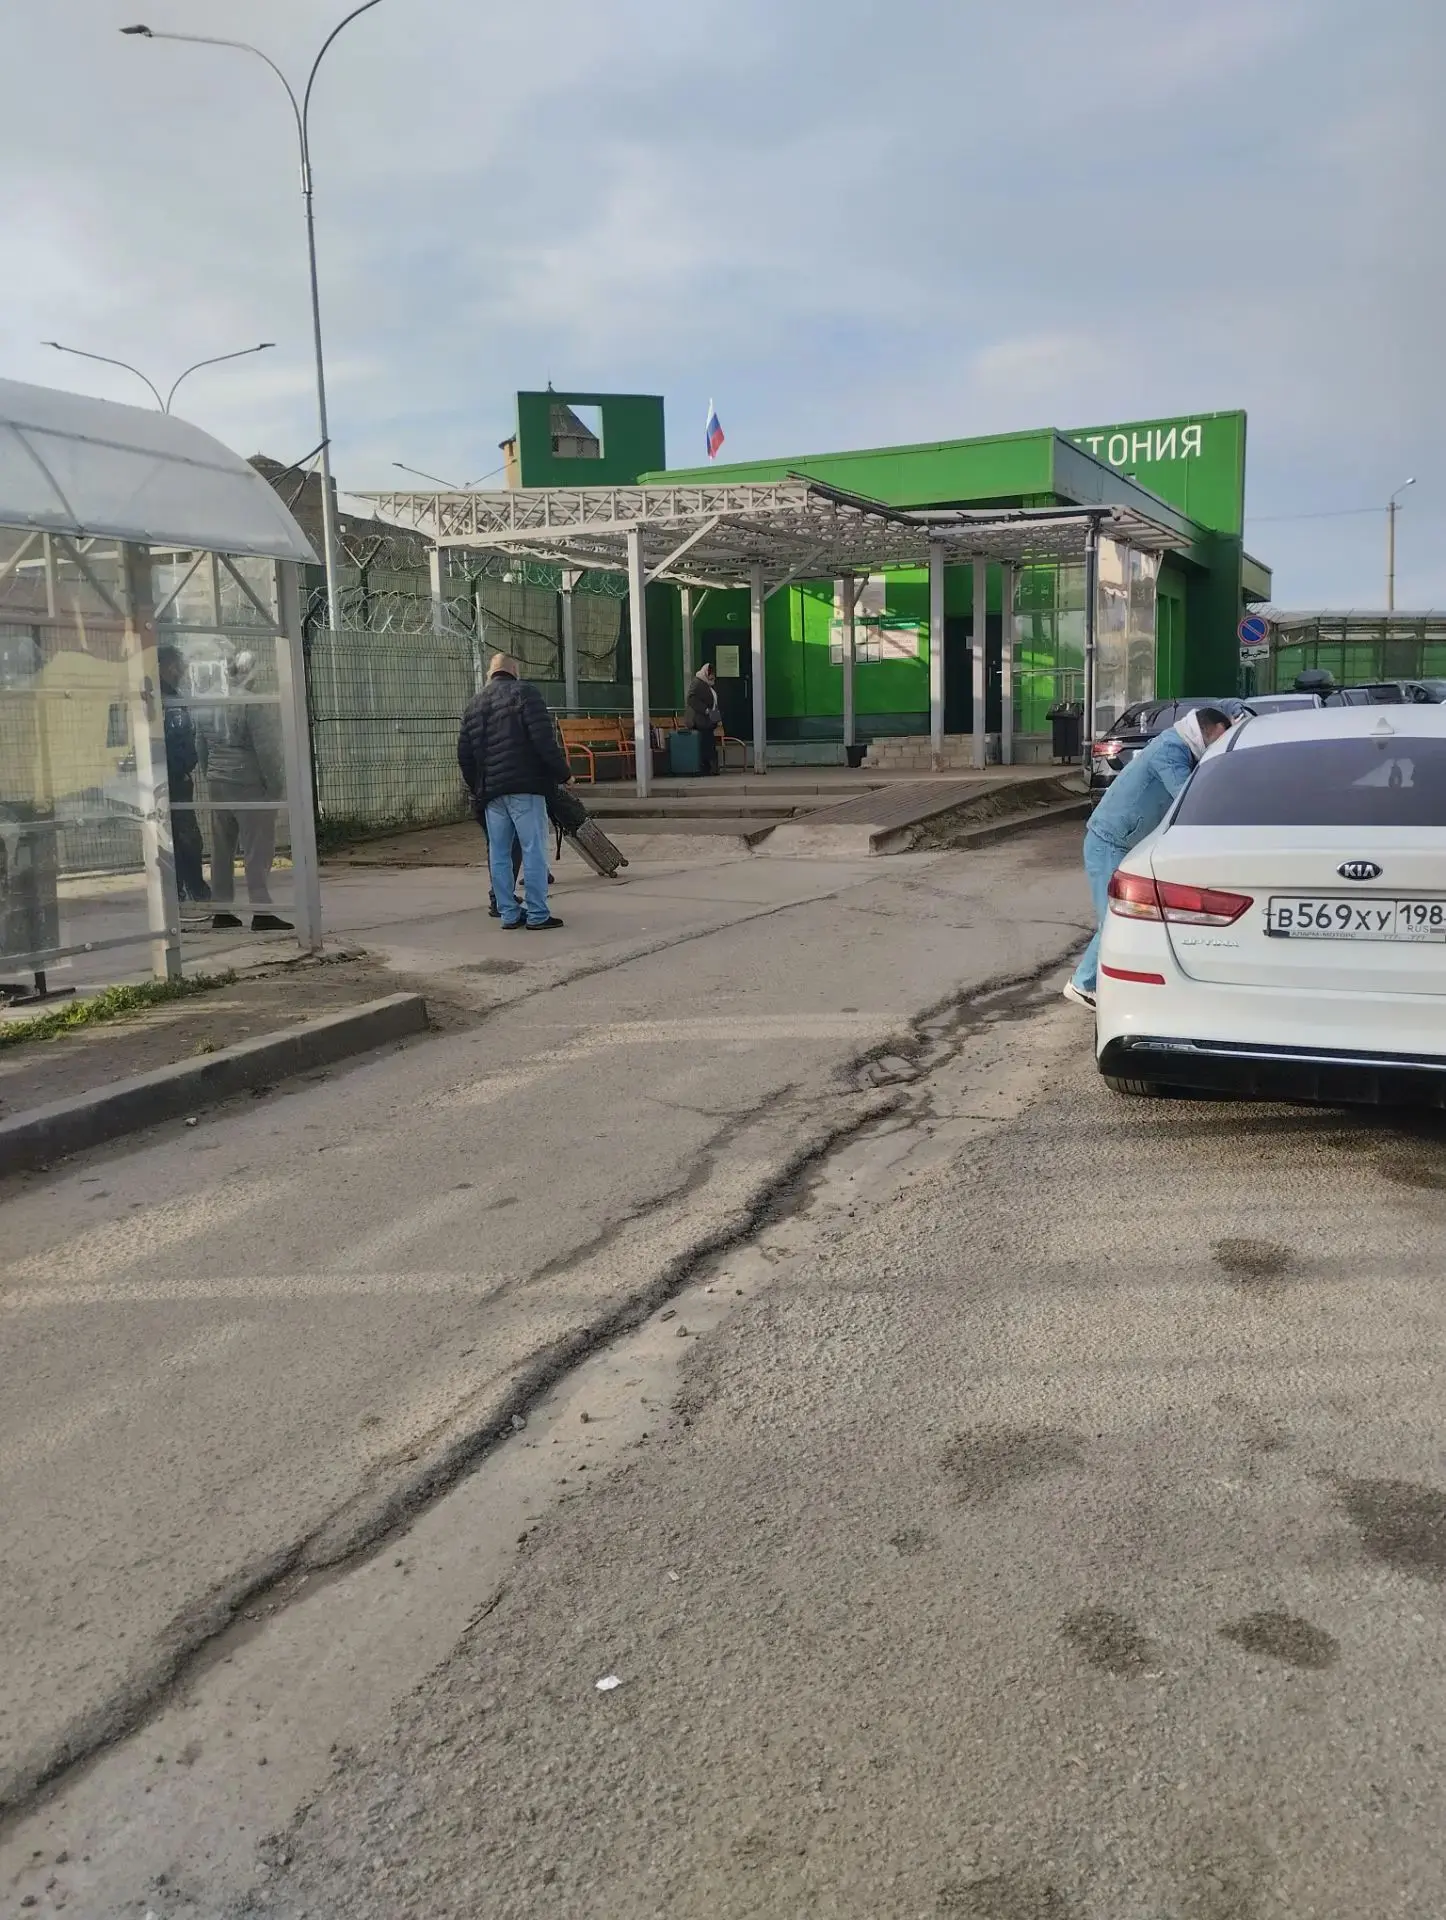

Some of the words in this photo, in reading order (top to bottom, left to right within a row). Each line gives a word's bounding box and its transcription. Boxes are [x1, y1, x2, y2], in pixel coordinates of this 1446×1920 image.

[1073, 424, 1203, 467] ТОНИЯ
[1344, 864, 1376, 877] KIA
[1278, 903, 1392, 930] В569ХУ
[1399, 904, 1443, 925] 198
[1407, 925, 1429, 933] RUS
